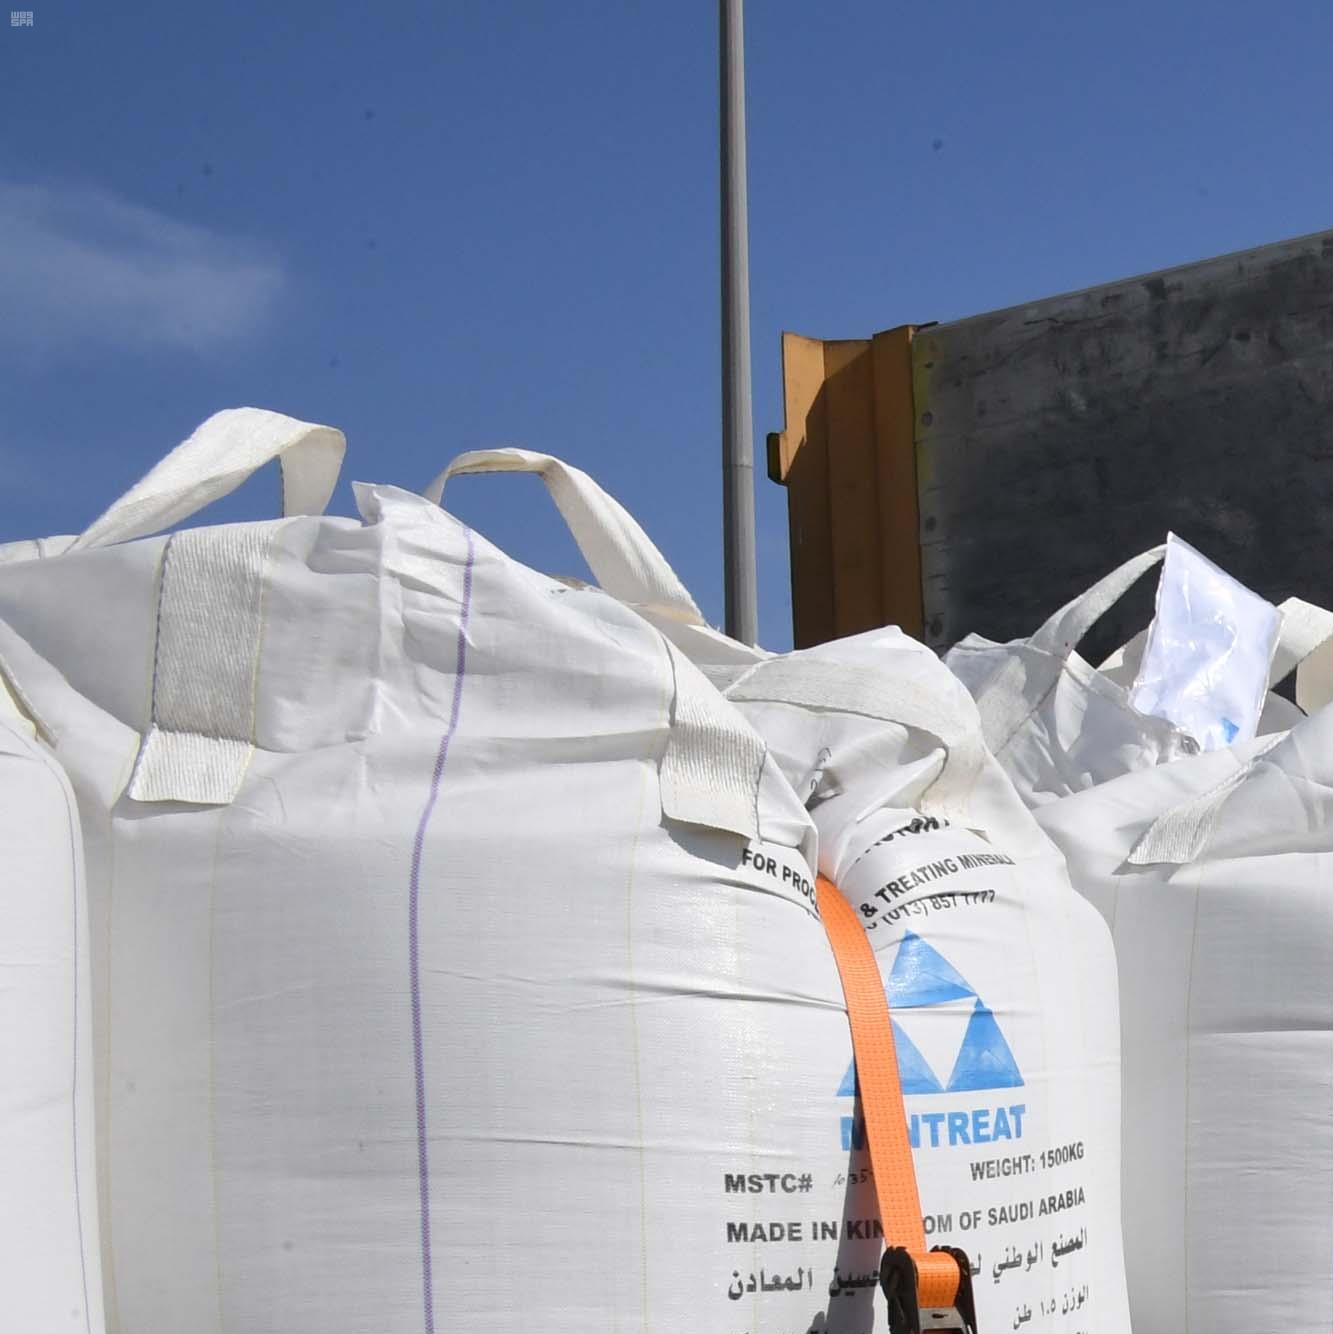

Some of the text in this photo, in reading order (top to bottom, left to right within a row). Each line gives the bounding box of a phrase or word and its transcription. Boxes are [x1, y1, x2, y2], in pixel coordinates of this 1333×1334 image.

[742, 848, 777, 877] FOR
[860, 902, 879, 918] &
[875, 858, 959, 904] TREATING
[970, 1141, 1084, 1181] WEIGHT: 1500KG
[724, 1173, 813, 1194] MSTC#
[727, 1221, 803, 1243] MADE
[812, 1220, 837, 1241] IN
[959, 1210, 982, 1231] OF
[988, 1201, 1034, 1226] SAUDI
[1038, 1186, 1086, 1217] ARABIA
[992, 1240, 1044, 1284] الوطني
[1051, 1226, 1088, 1268] المصنع
[728, 1266, 813, 1301] المعادن
[1062, 1284, 1089, 1315] الوزن
[1013, 1303, 1032, 1330] طن
